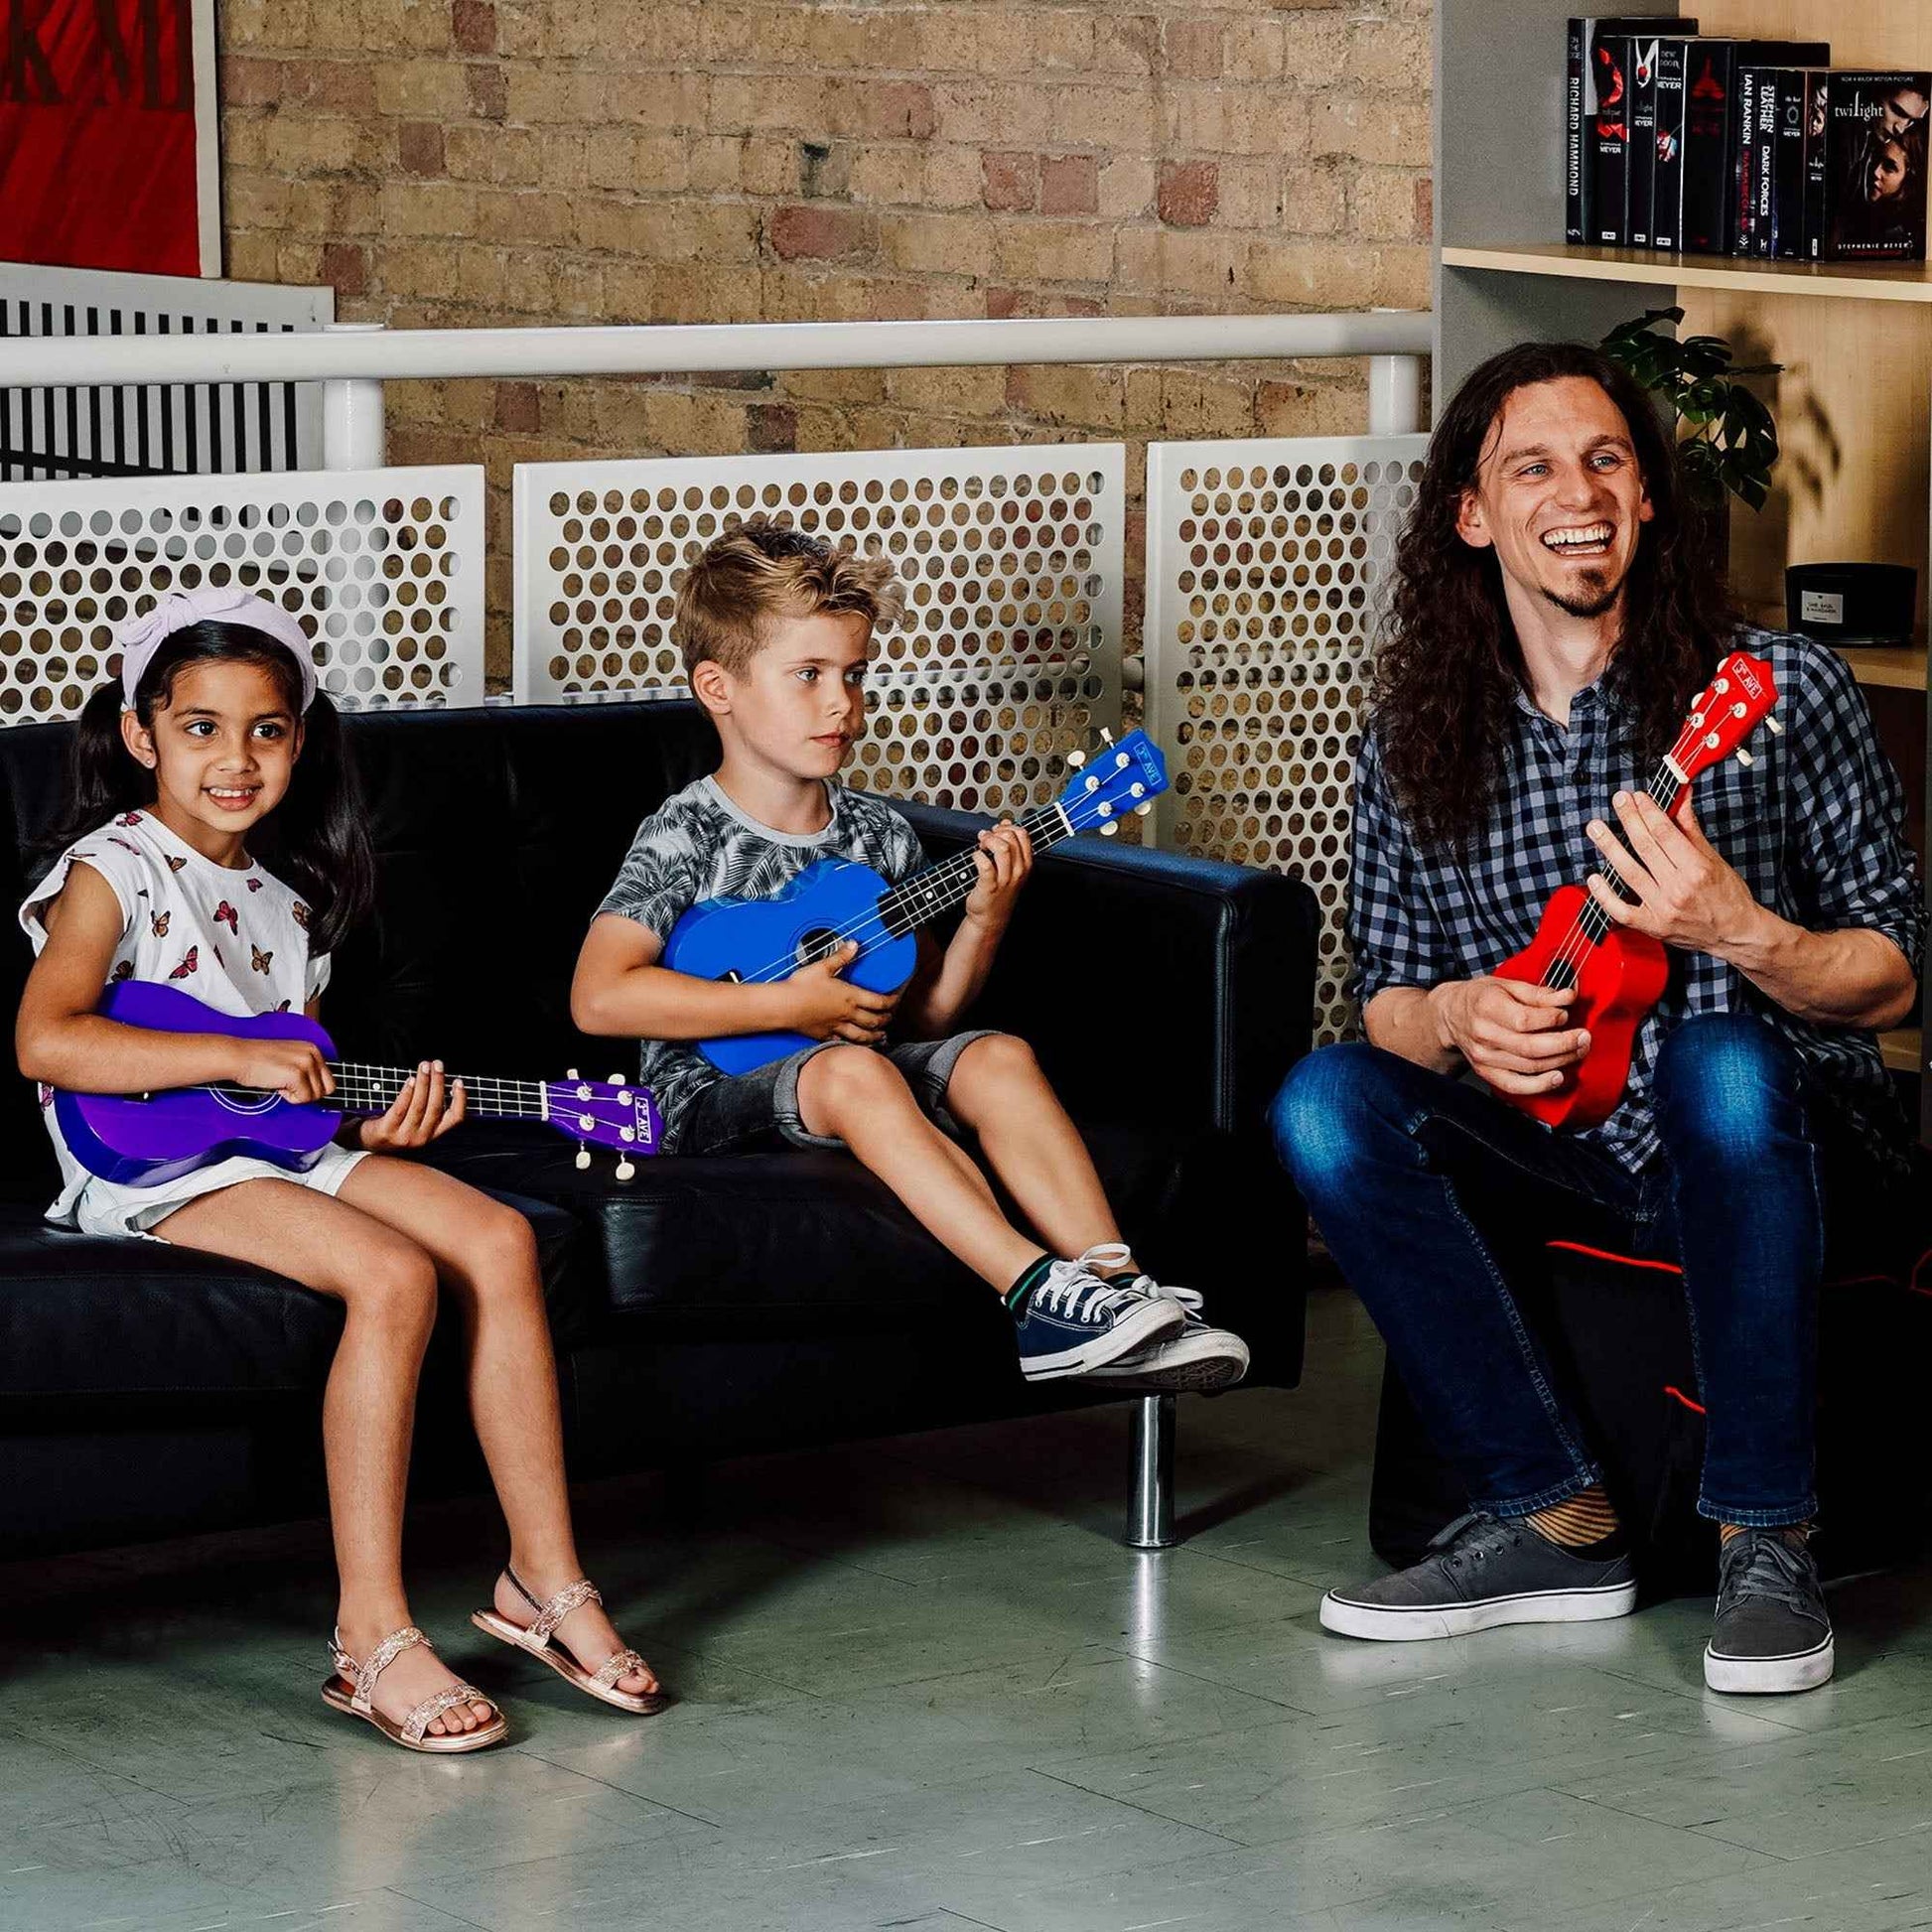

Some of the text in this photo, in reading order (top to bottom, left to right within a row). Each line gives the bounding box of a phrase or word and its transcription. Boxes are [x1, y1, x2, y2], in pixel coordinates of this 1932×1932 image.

[1742, 98, 1752, 145] RANKIN
[1765, 85, 1775, 133] STEPHEN
[1835, 90, 1884, 122] twilight
[1569, 77, 1580, 196] RICHARD HAMMOND
[1760, 145, 1770, 216] DARK FORCES
